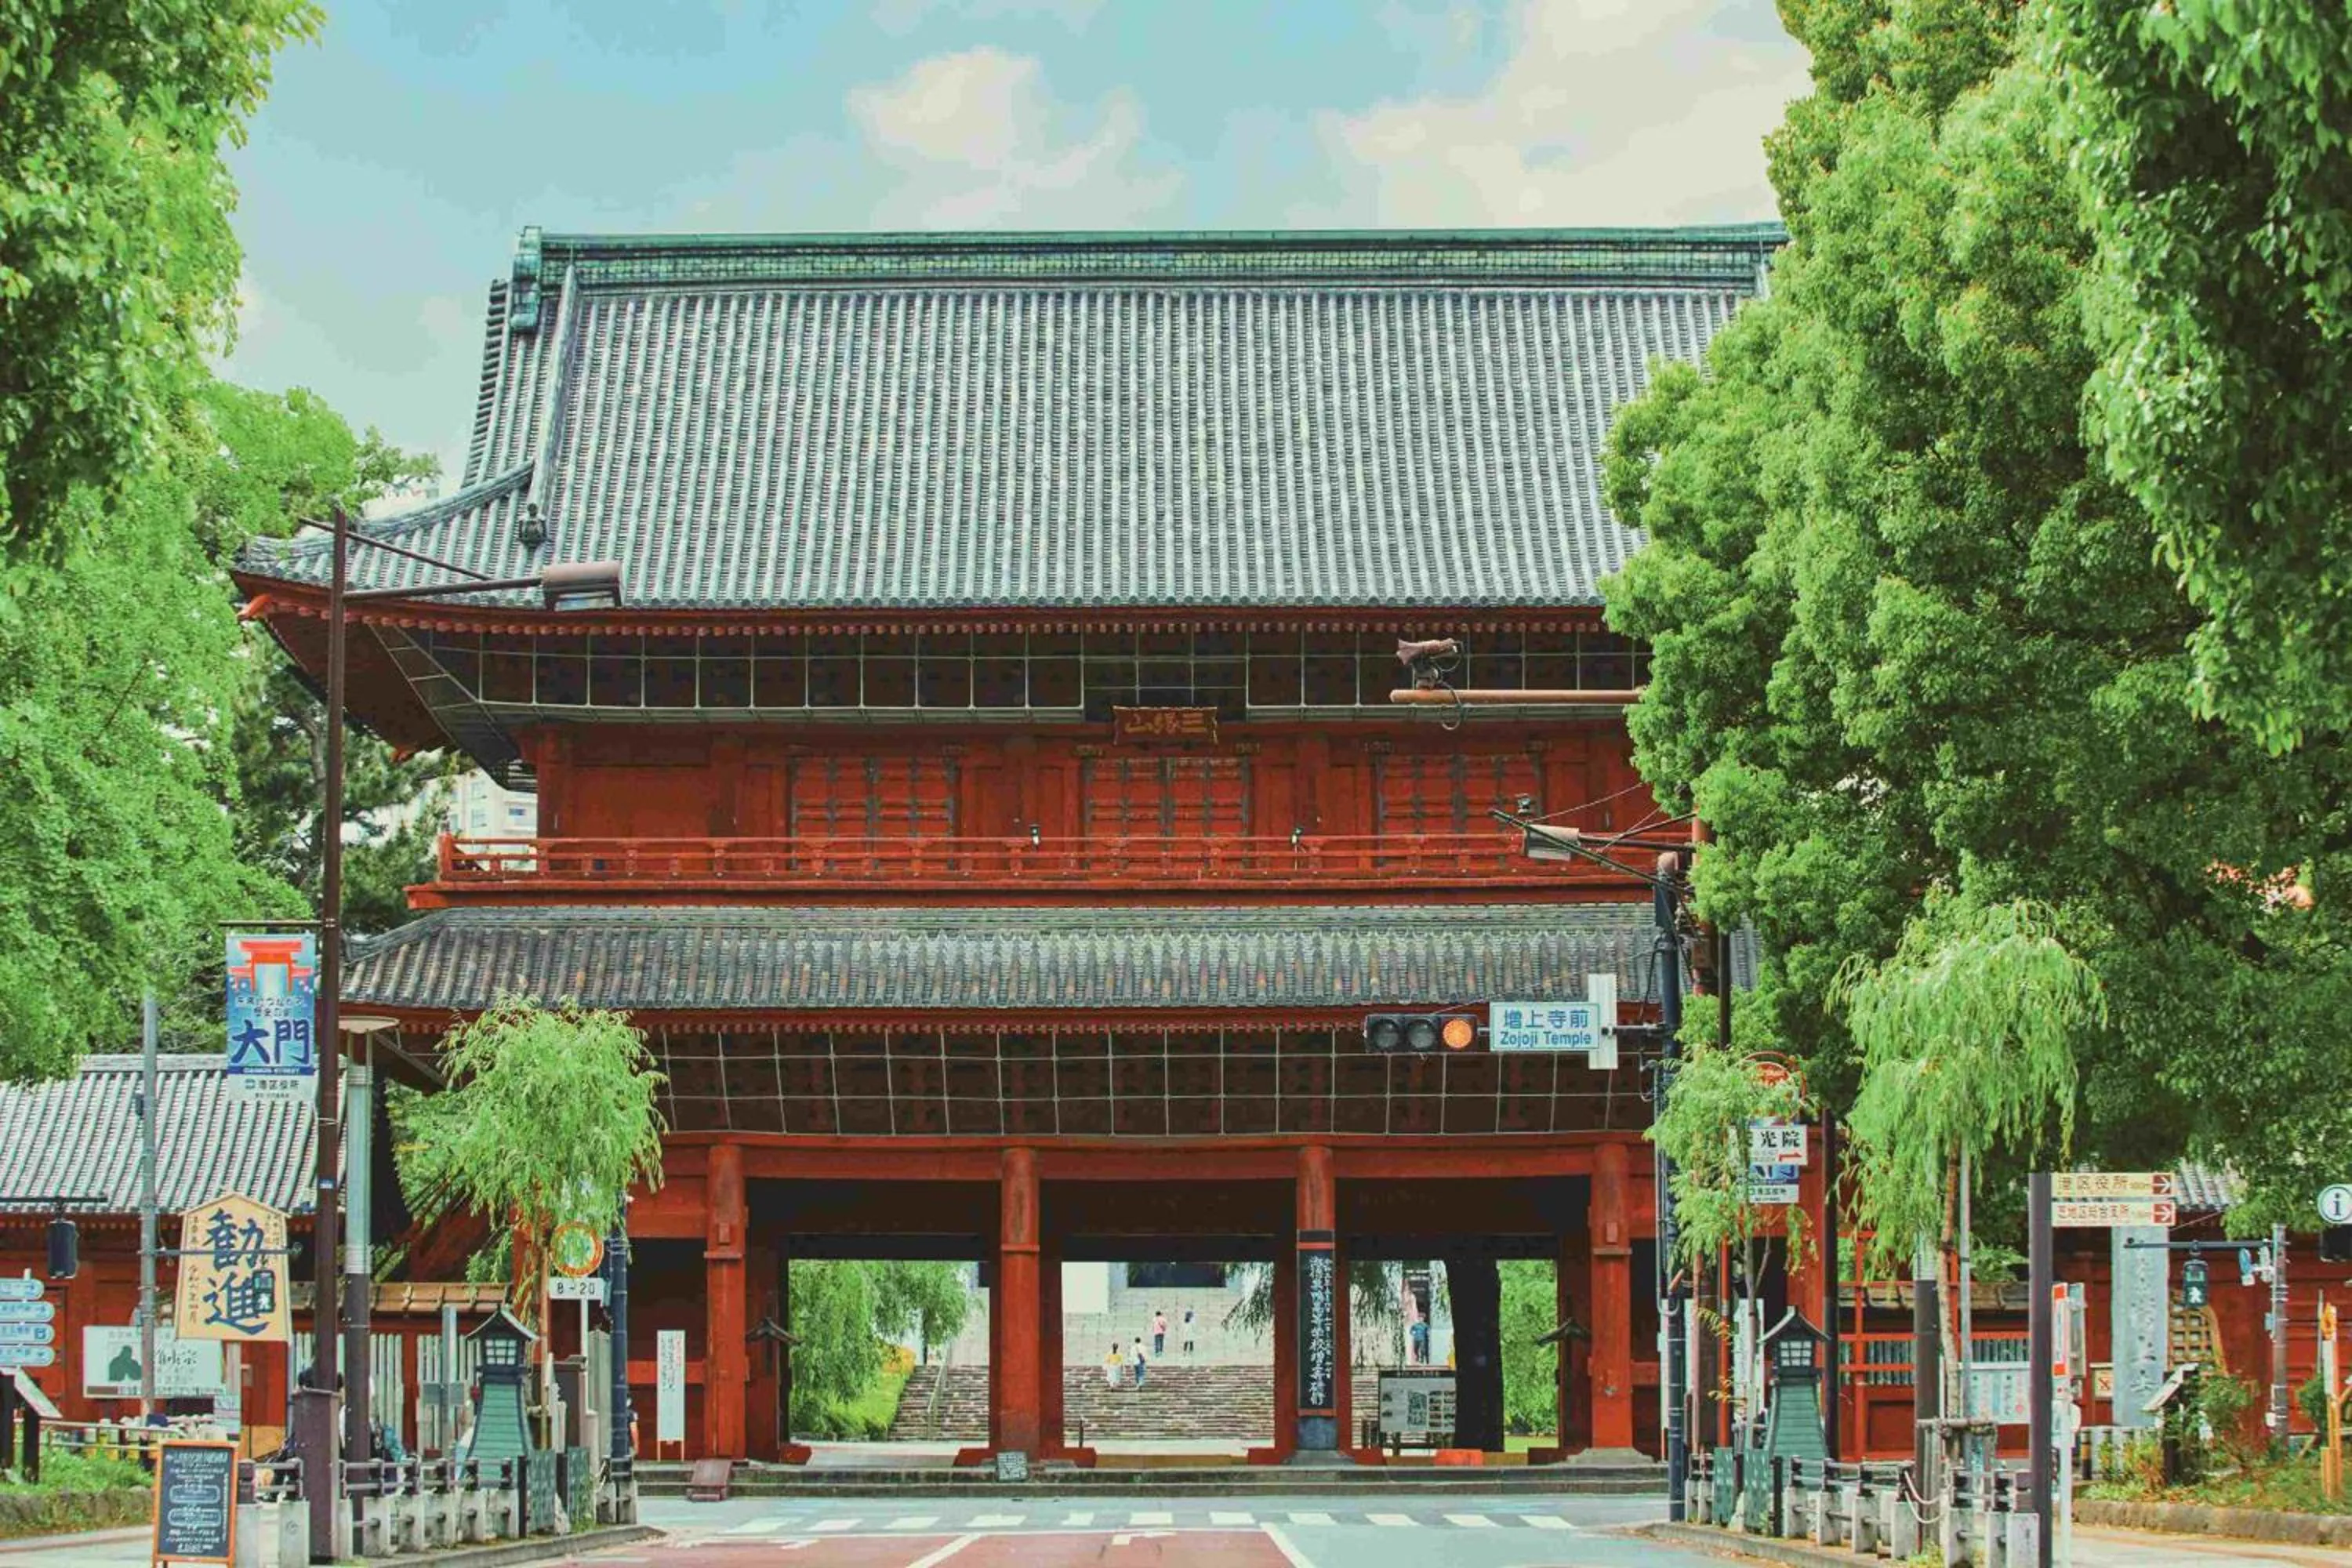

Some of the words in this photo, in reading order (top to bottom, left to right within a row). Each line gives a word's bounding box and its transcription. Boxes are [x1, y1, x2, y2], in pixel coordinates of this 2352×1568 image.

[1504, 1009, 1589, 1029] 増上寺前
[230, 1018, 310, 1065] 大門
[1500, 1031, 1538, 1048] Zojoji
[1542, 1030, 1592, 1048] Temple
